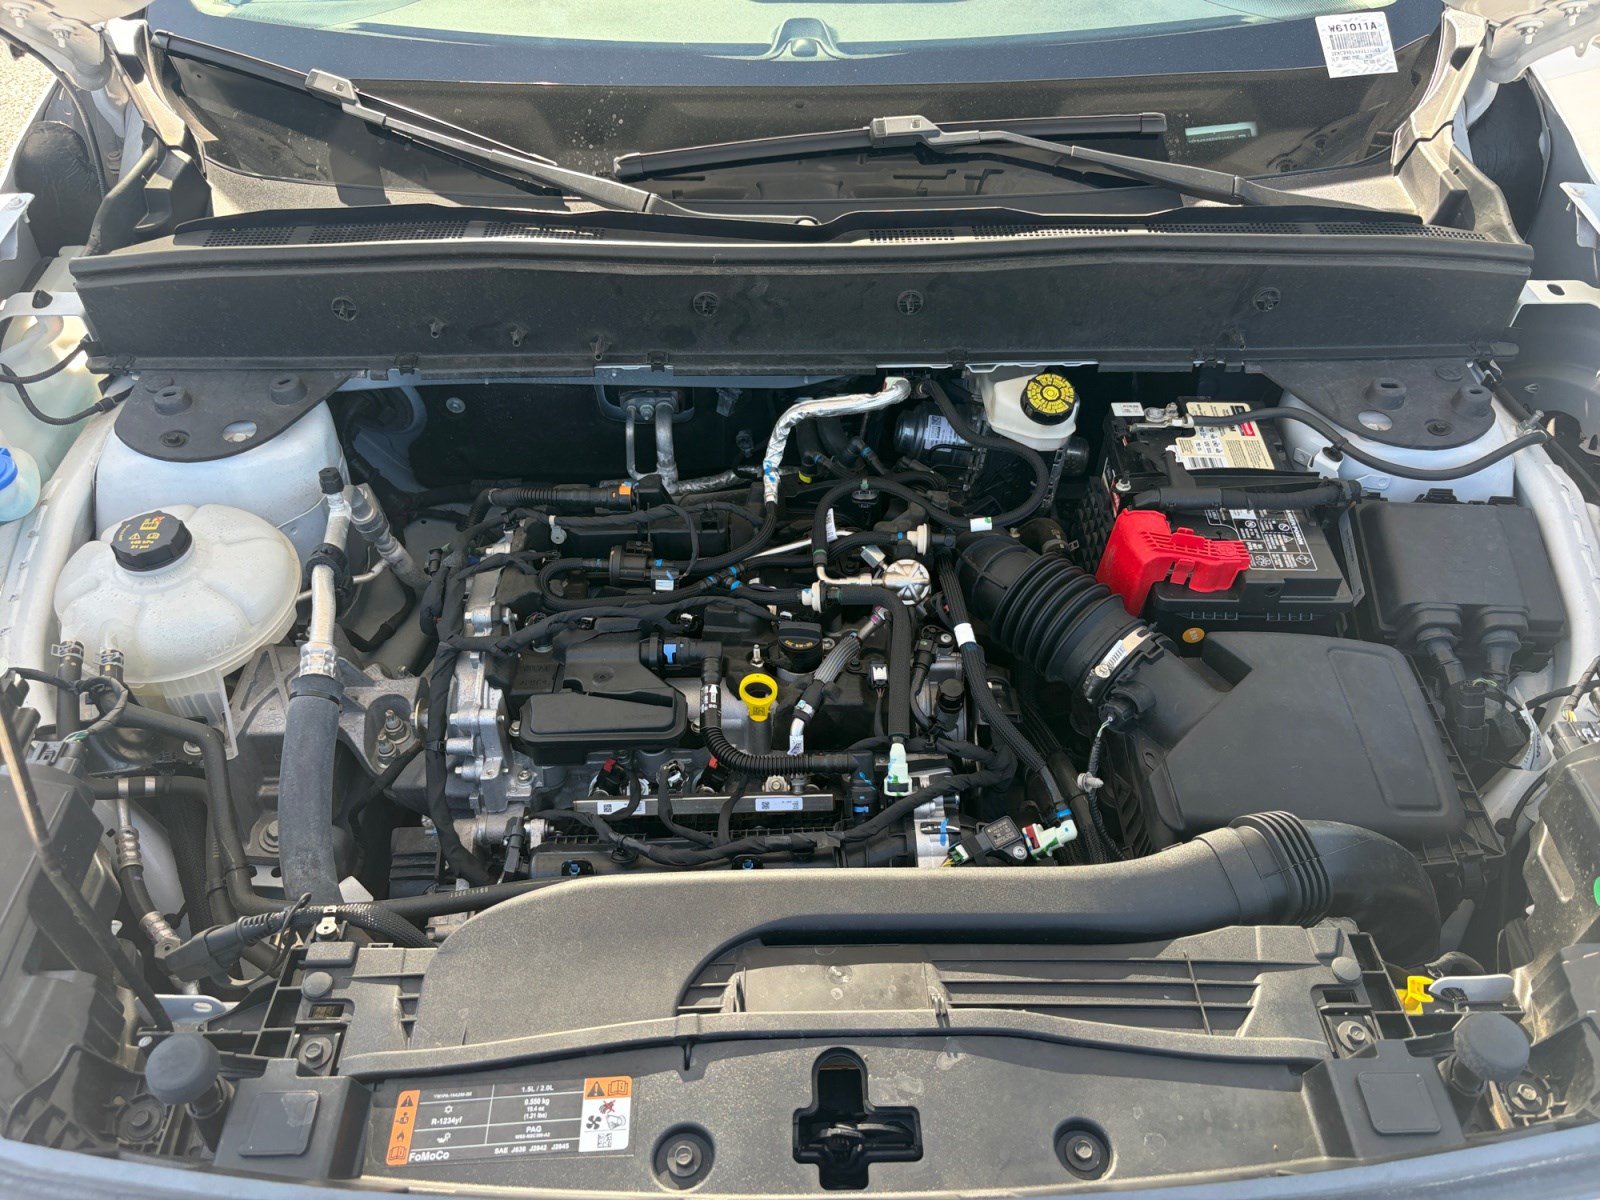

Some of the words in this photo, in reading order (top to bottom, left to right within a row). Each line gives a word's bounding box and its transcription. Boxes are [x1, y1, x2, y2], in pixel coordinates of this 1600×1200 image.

[1328, 21, 1377, 33] W61011A
[541, 1097, 550, 1106] kg
[431, 1116, 463, 1126] R-1234yf
[494, 1147, 509, 1155] SAE
[408, 1150, 450, 1163] FoMoCo
